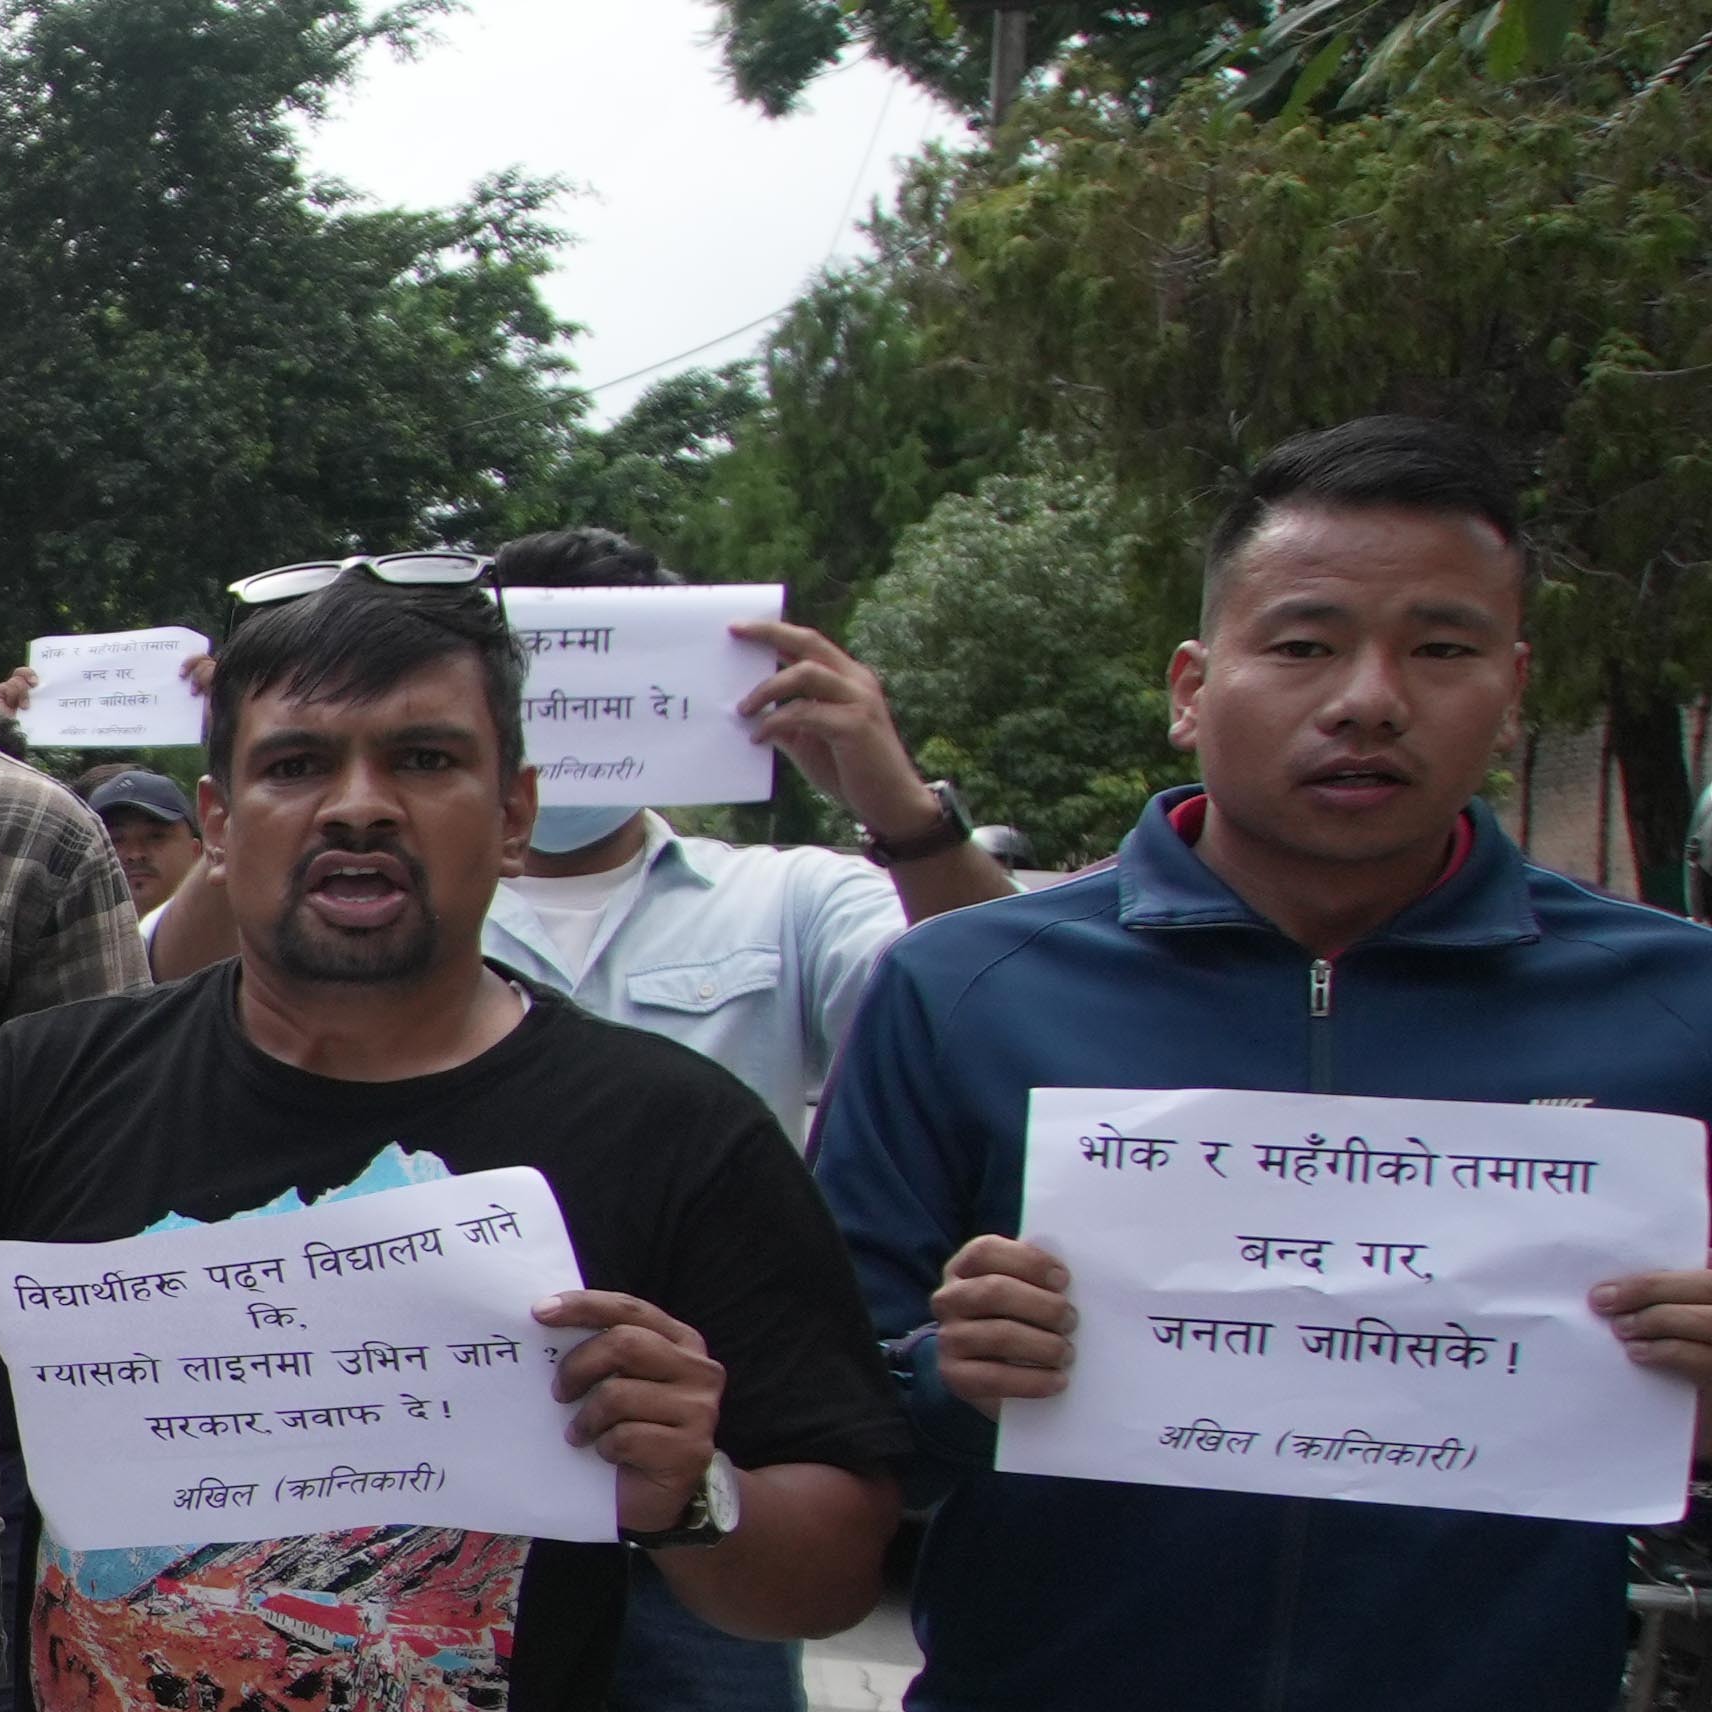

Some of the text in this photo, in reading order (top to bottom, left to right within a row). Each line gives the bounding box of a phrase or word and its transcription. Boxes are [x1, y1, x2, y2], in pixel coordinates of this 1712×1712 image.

[518, 627, 615, 654] कम्मा
[522, 688, 636, 722] ाजीनामा
[1078, 1122, 1600, 1195] भोक र महँगीको तमासा
[203, 1257, 286, 1294] पढ्न
[304, 1228, 443, 1282] विद्यालय
[457, 1203, 523, 1247] जाने
[1236, 1233, 1334, 1276] बन्द
[1148, 1316, 1275, 1357] जनता
[32, 1352, 162, 1387] ग्यासको
[181, 1351, 315, 1383] लाइनमा
[332, 1340, 430, 1377] उभिन
[448, 1334, 523, 1366] जाने
[277, 1400, 384, 1430] जवाफ
[1157, 1417, 1480, 1472] अखिल (क्रान्तिकारी)
[172, 1462, 446, 1511] अखिल (क्रान्तिकारी)
